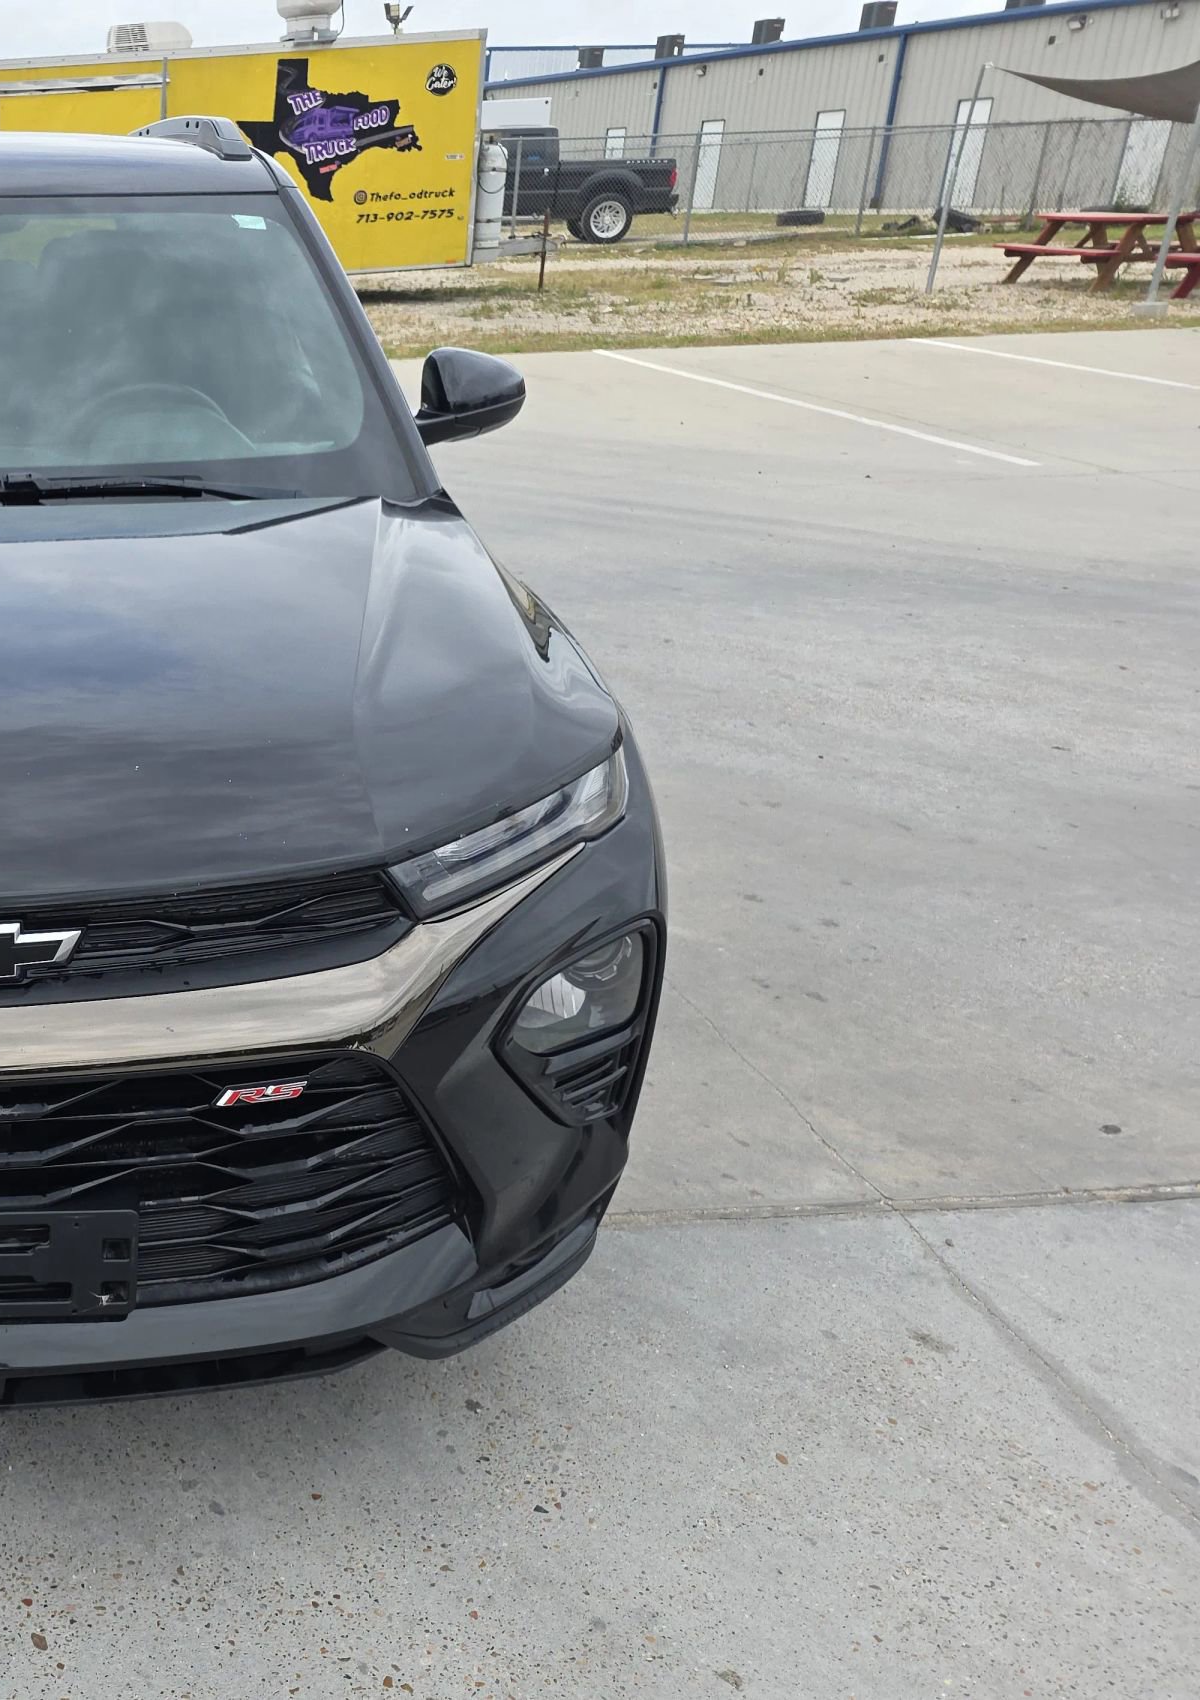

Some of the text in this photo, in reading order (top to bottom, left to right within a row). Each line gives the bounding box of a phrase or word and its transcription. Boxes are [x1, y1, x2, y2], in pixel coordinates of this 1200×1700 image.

[433, 65, 449, 78] We
[287, 90, 325, 115] THE
[353, 105, 390, 131] FOOD
[302, 138, 357, 165] TRUCK
[356, 208, 455, 224] 713-902-7575
[216, 1080, 308, 1107] RS
